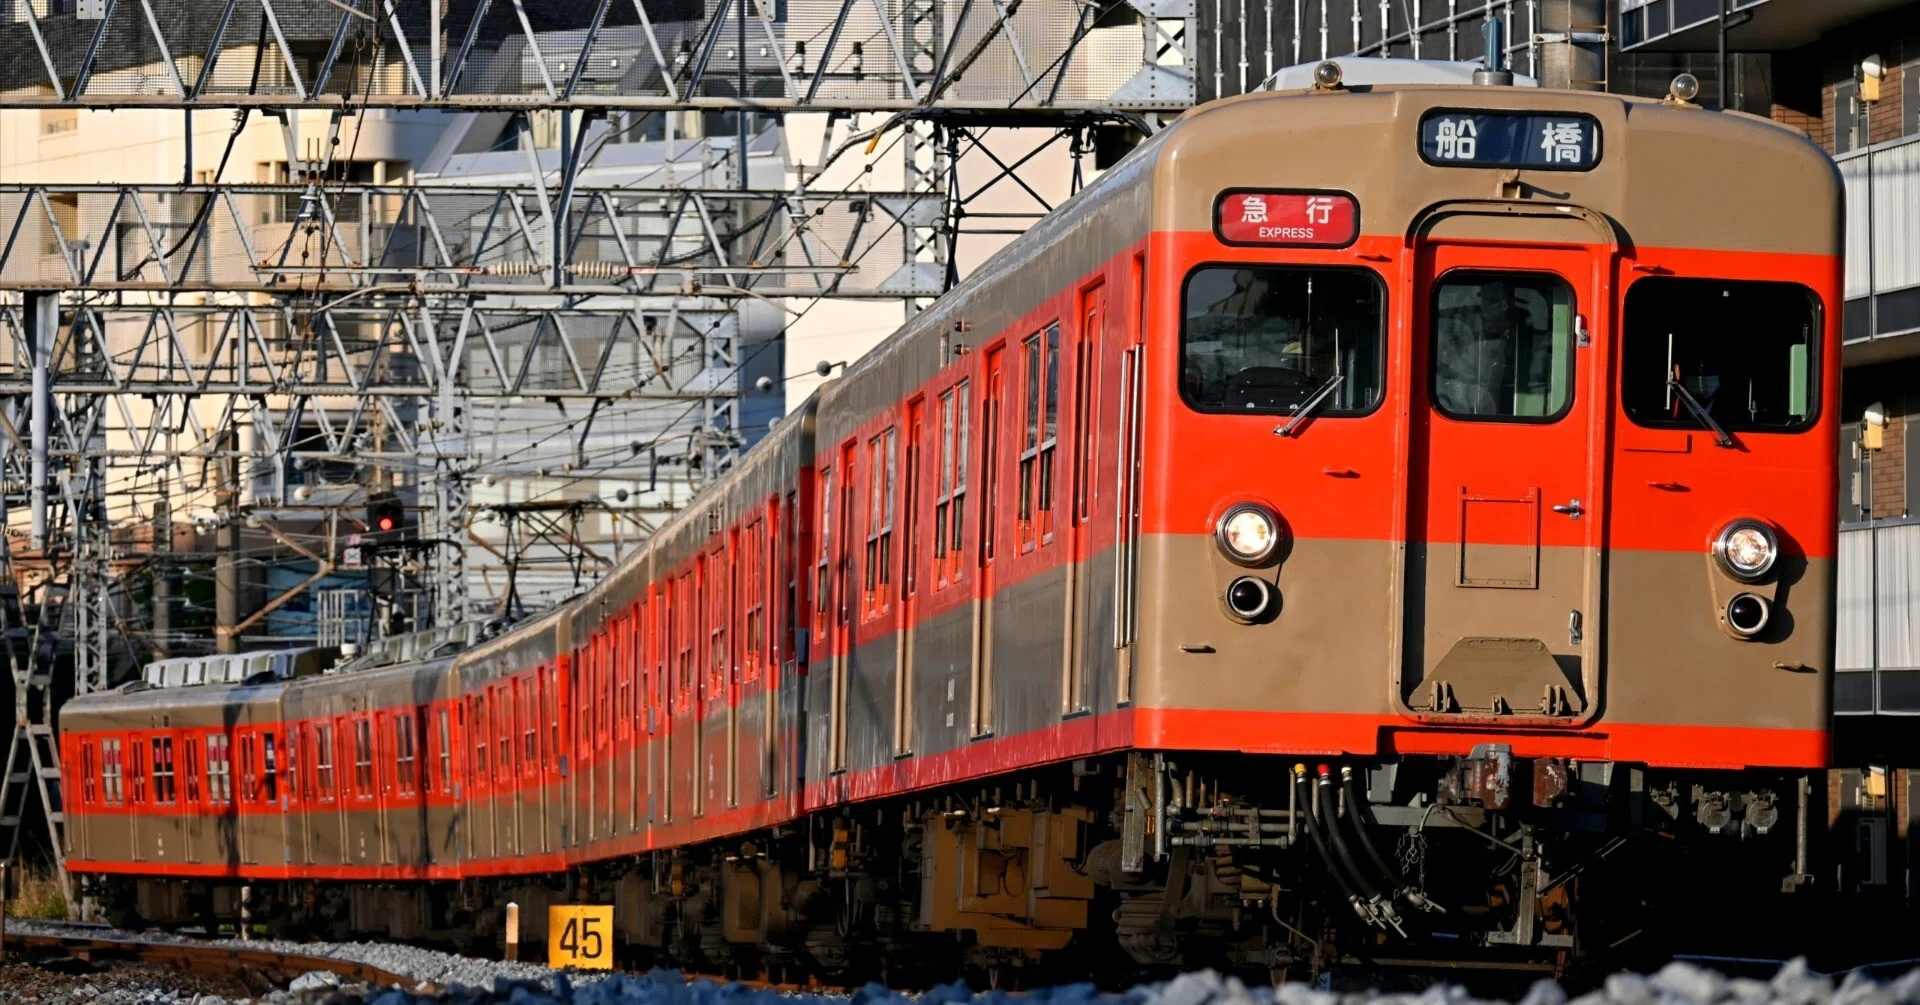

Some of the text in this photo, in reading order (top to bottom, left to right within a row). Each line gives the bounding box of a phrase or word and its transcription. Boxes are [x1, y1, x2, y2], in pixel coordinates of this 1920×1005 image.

[1435, 118, 1582, 163] 船橋
[1241, 196, 1333, 224] 急行
[1259, 227, 1314, 238] EXPRESS
[560, 918, 602, 958] 45
